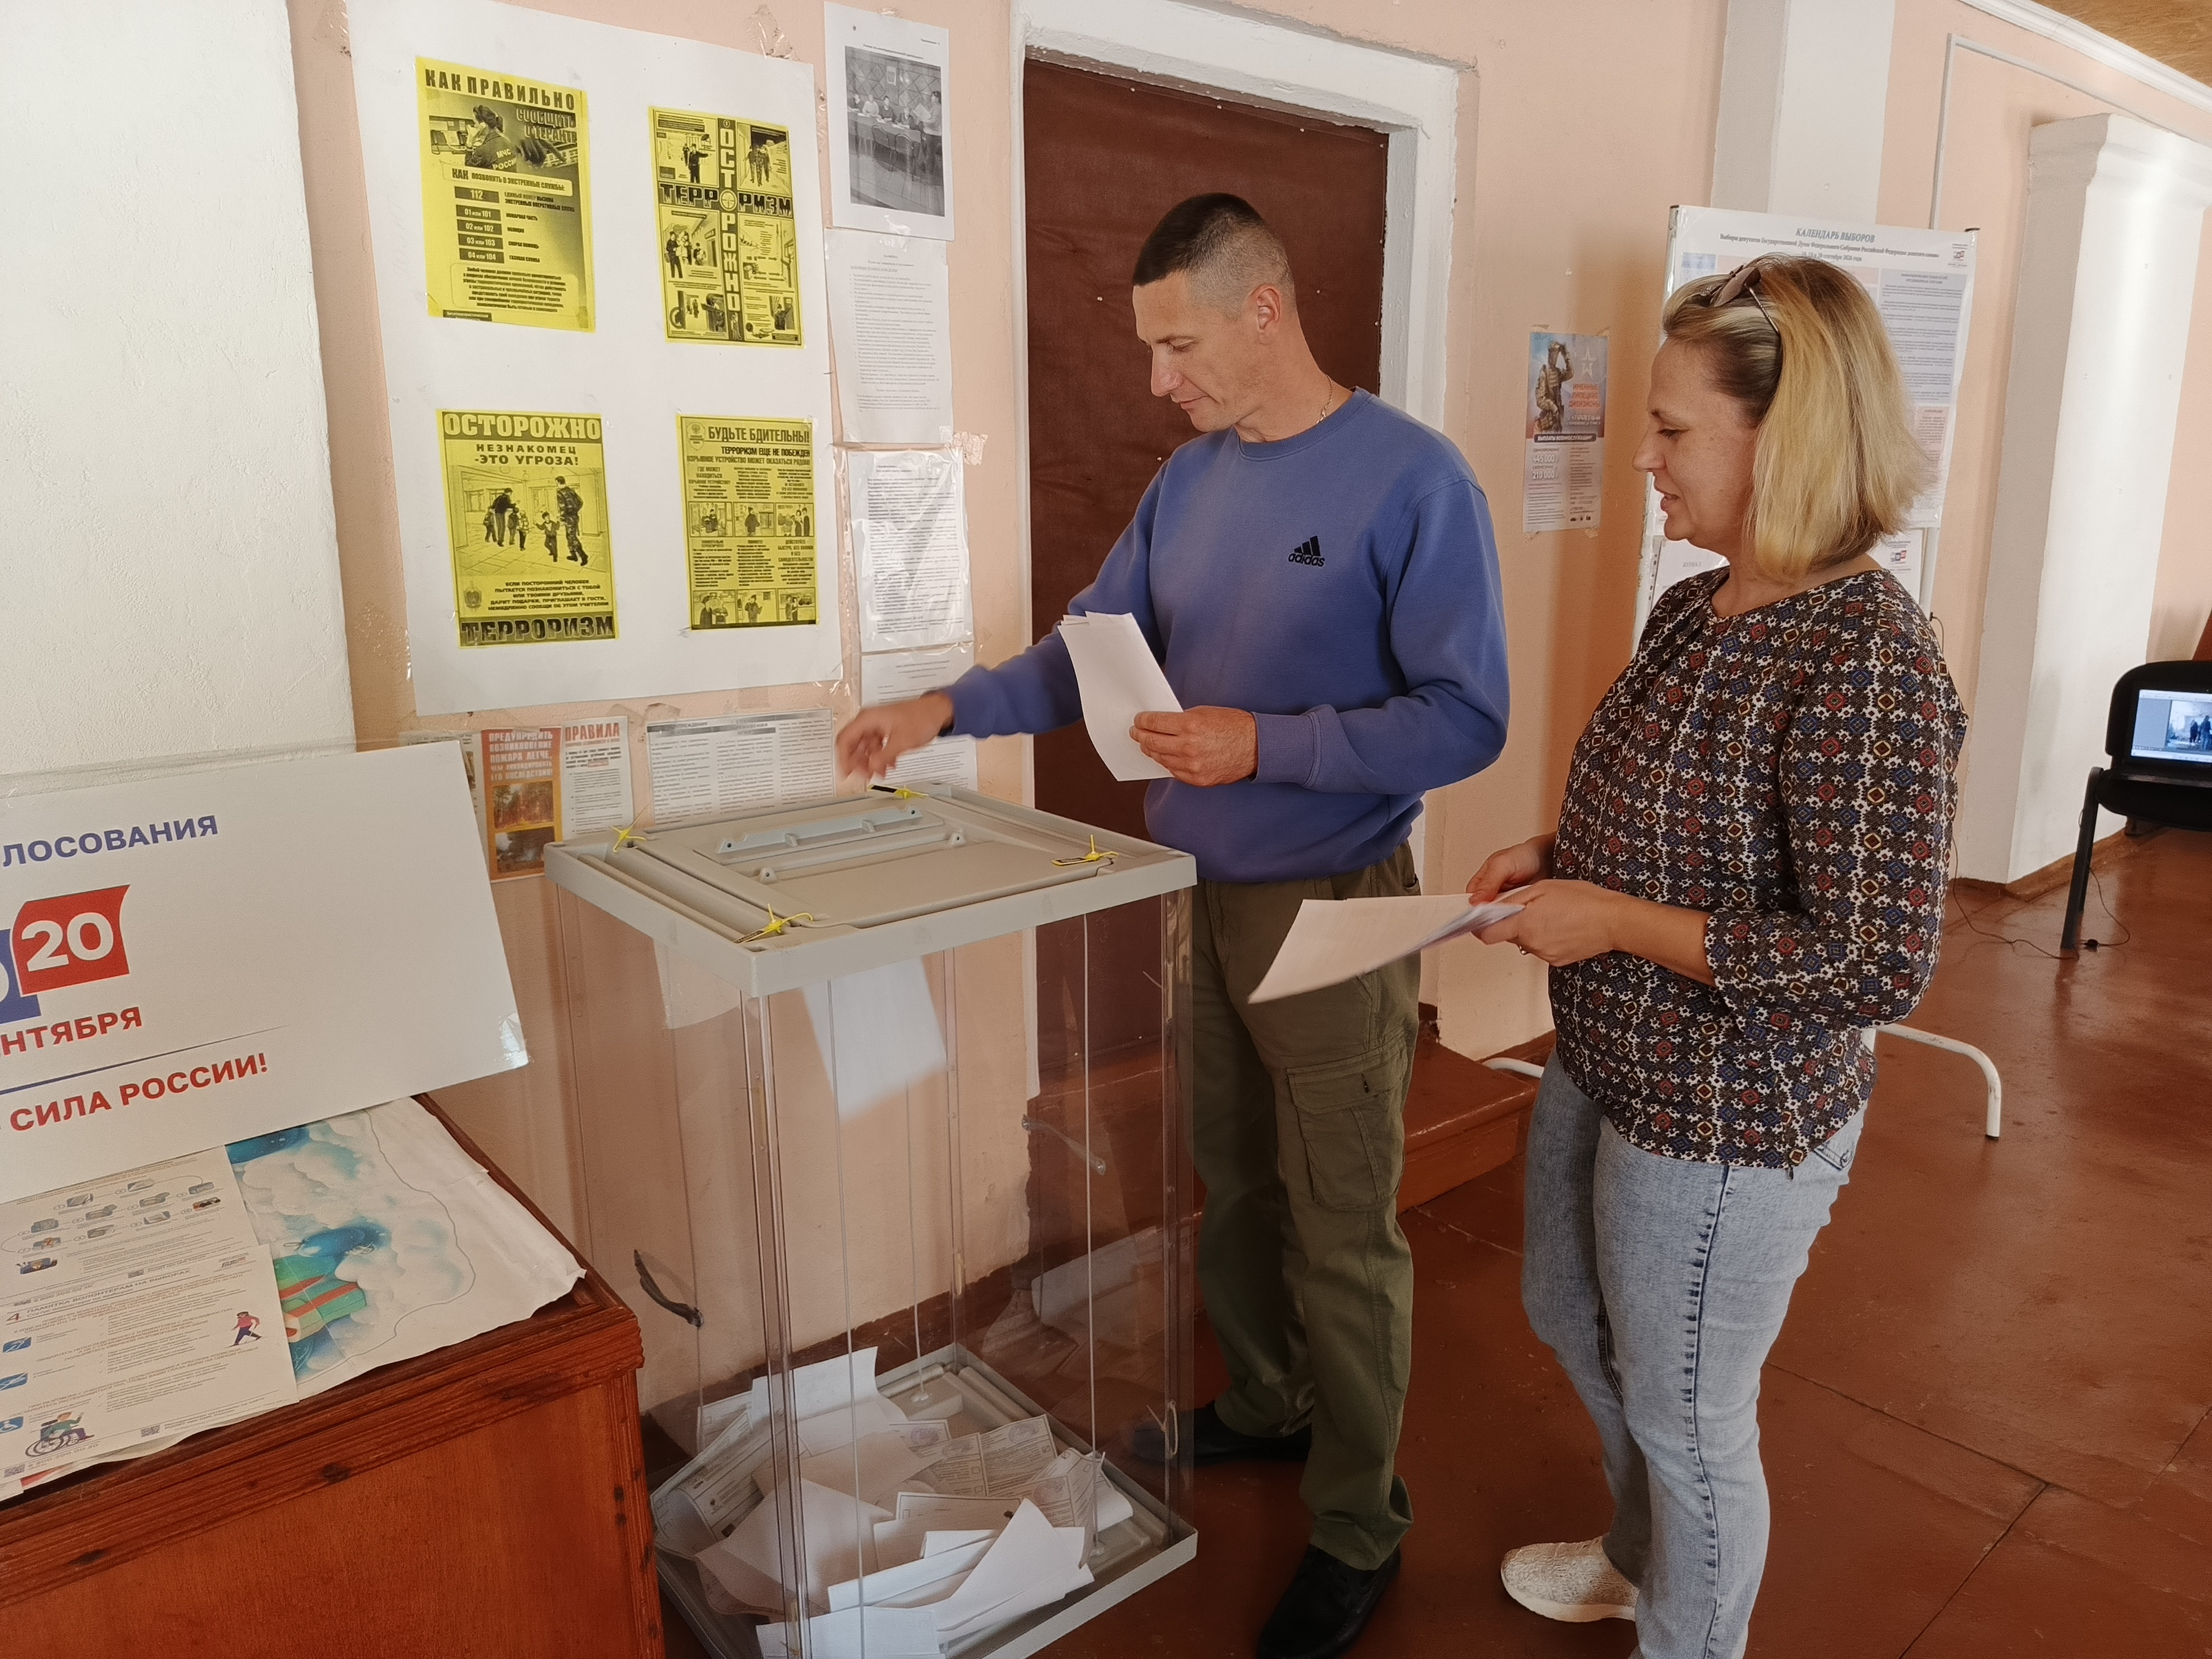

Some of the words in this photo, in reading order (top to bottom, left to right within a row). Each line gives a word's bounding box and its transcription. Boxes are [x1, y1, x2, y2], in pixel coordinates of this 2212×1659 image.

[425, 69, 461, 91] КАК
[467, 76, 575, 110] ПРАВИЛЬНО
[517, 108, 576, 128] СООБЩИТЬ
[496, 148, 511, 159] МЧС
[472, 172, 502, 183] ПОЗВОНИТЬ
[507, 178, 540, 188] ЭКСТРЕННЫЕ
[470, 190, 483, 199] 112
[1796, 227, 1840, 240] КАЛЕНДАРЬ
[1840, 232, 1875, 242] ВЫБОРОВ
[444, 413, 601, 440] ОСТОРОЖНО
[708, 426, 747, 442] БУДЬТЕ
[749, 429, 810, 444] БДИТЕЛЬНЫ!
[476, 443, 576, 455] НЕЗНАКОМЕЦ
[721, 446, 757, 455] ТЕРРОРИЗМ
[781, 449, 810, 458] ПОБЕЖДЕН
[475, 454, 509, 465] -ЭТО
[515, 455, 579, 466] УГРОЗА!
[715, 455, 746, 464] УСТРОЙСТВО
[1288, 553, 1326, 567] adidas
[461, 616, 614, 643] ТЕРРОРИЗМ
[565, 722, 620, 741] ПРАВИЛА
[490, 752, 523, 764] ПОЖАРА
[3, 815, 219, 867] ЛОСОВАНИЯ
[21, 911, 114, 972] 20
[9, 1091, 112, 1132] СИЛА
[119, 1053, 268, 1106] РОССИИ!
[26, 1299, 70, 1314] ПАМЯТКА
[72, 1283, 133, 1303] ВОЛОНТЕРАМ
[149, 1269, 190, 1283] ВЫБОРАХ
[6, 1312, 20, 1323] 4
